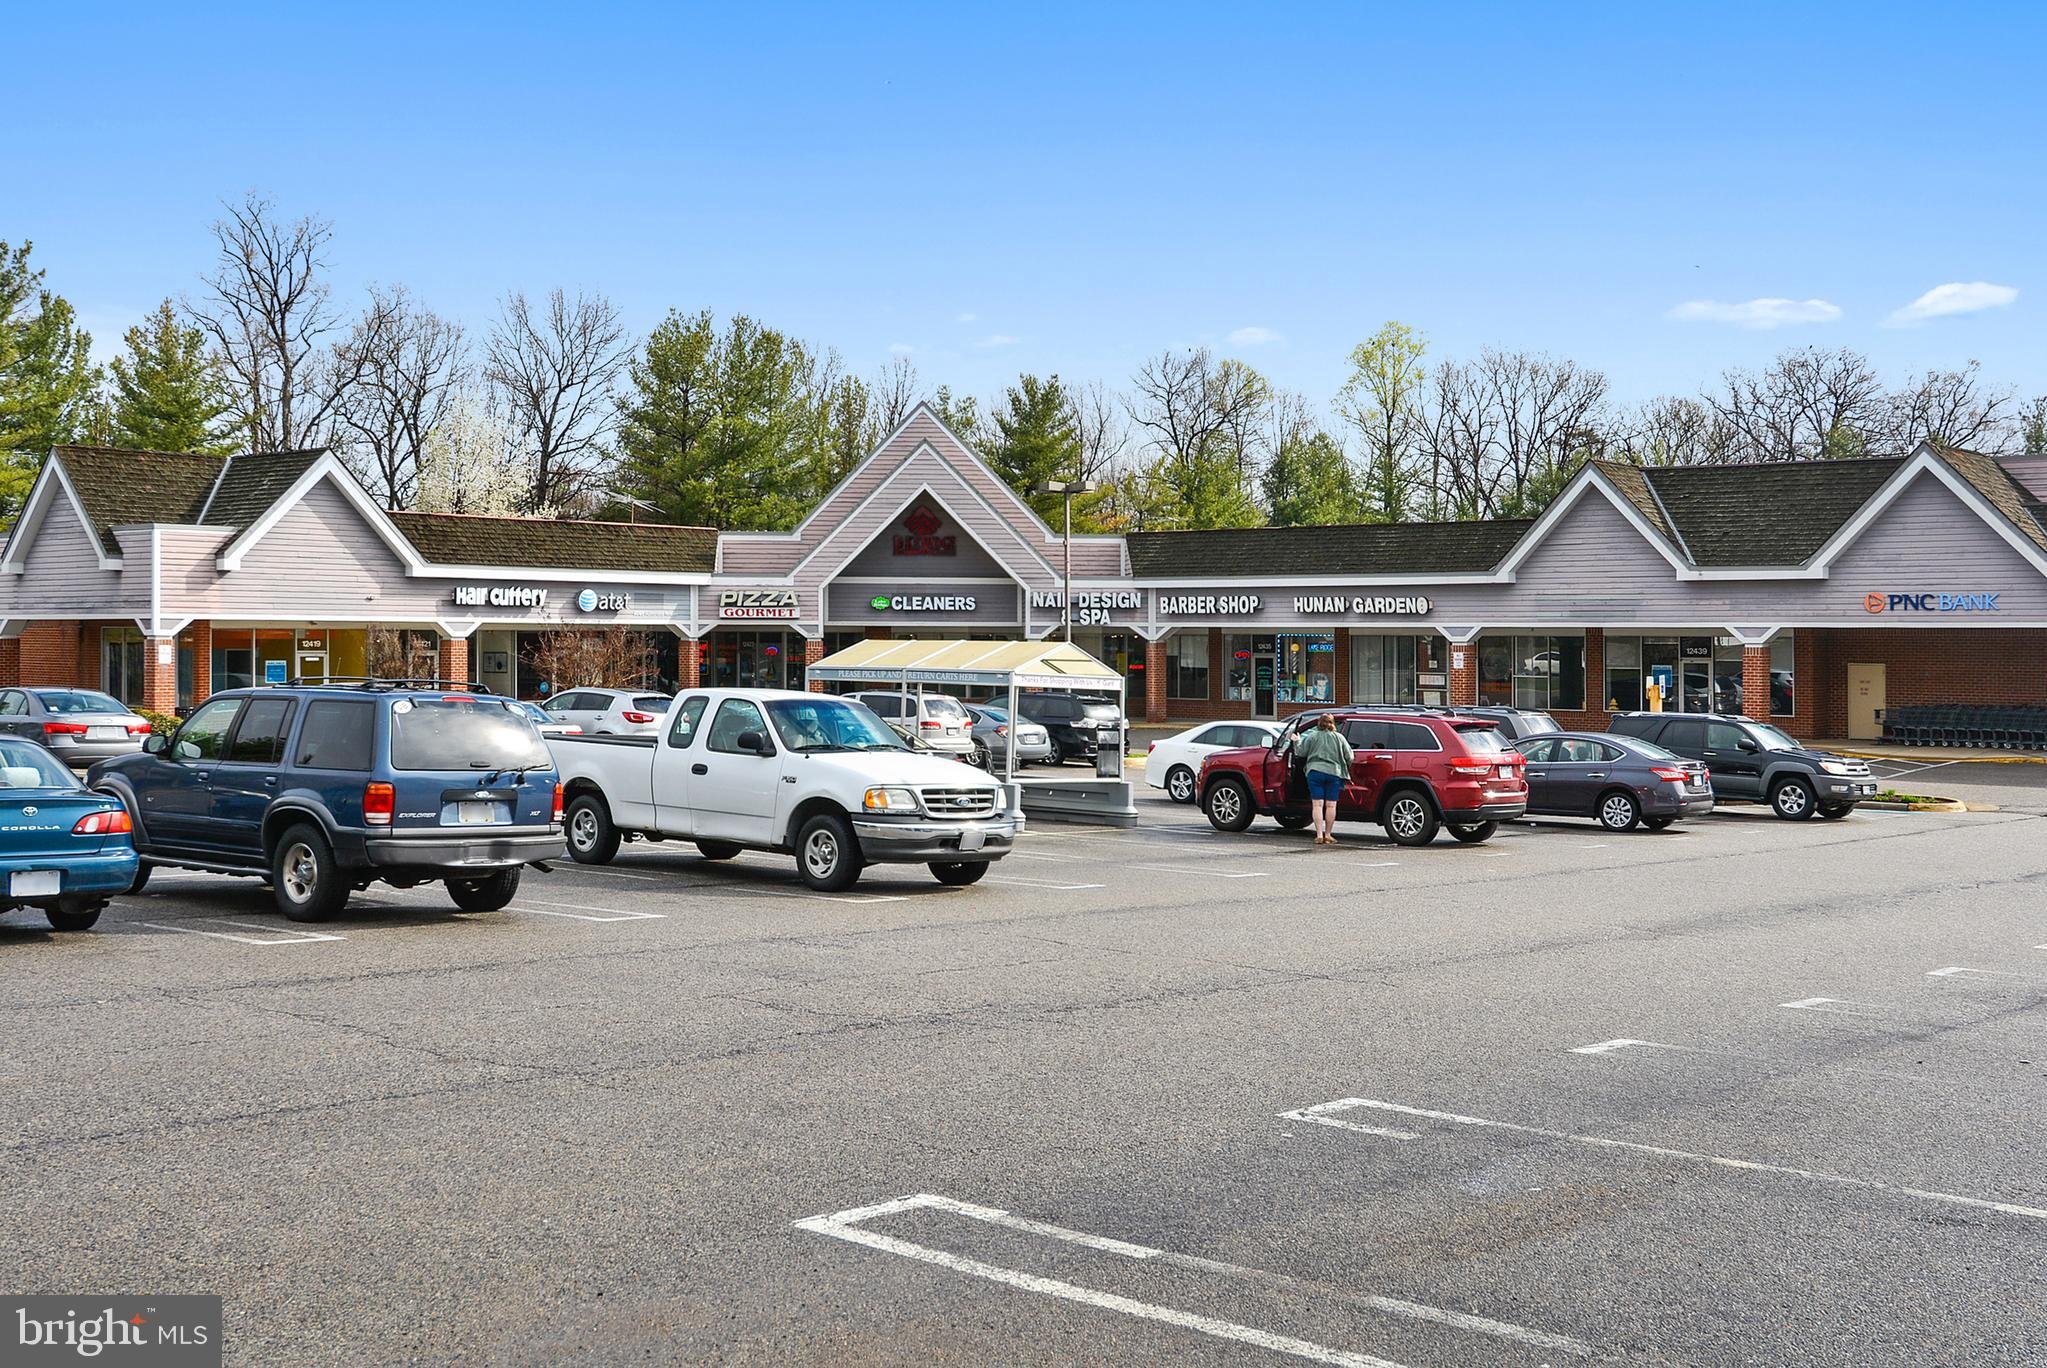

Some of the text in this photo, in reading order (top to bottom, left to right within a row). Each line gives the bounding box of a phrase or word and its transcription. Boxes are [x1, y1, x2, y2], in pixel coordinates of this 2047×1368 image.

[455, 587, 488, 605] Hair
[598, 592, 631, 610] at&t
[720, 590, 799, 606] PIZZA
[891, 596, 976, 610] CLEANERS
[1078, 592, 1142, 608] DESIGN
[1888, 592, 2000, 611] PNC BANK
[724, 608, 796, 617] GOURMET
[1160, 595, 1259, 614] BARBER SHOP
[1293, 597, 1345, 613] HUNAN
[1079, 609, 1111, 625] SPA
[301, 640, 322, 648] 12419
[838, 670, 977, 682] PLEASE PICK UP AND RETURN CARTS HERE
[1050, 677, 1073, 687] Shopping
